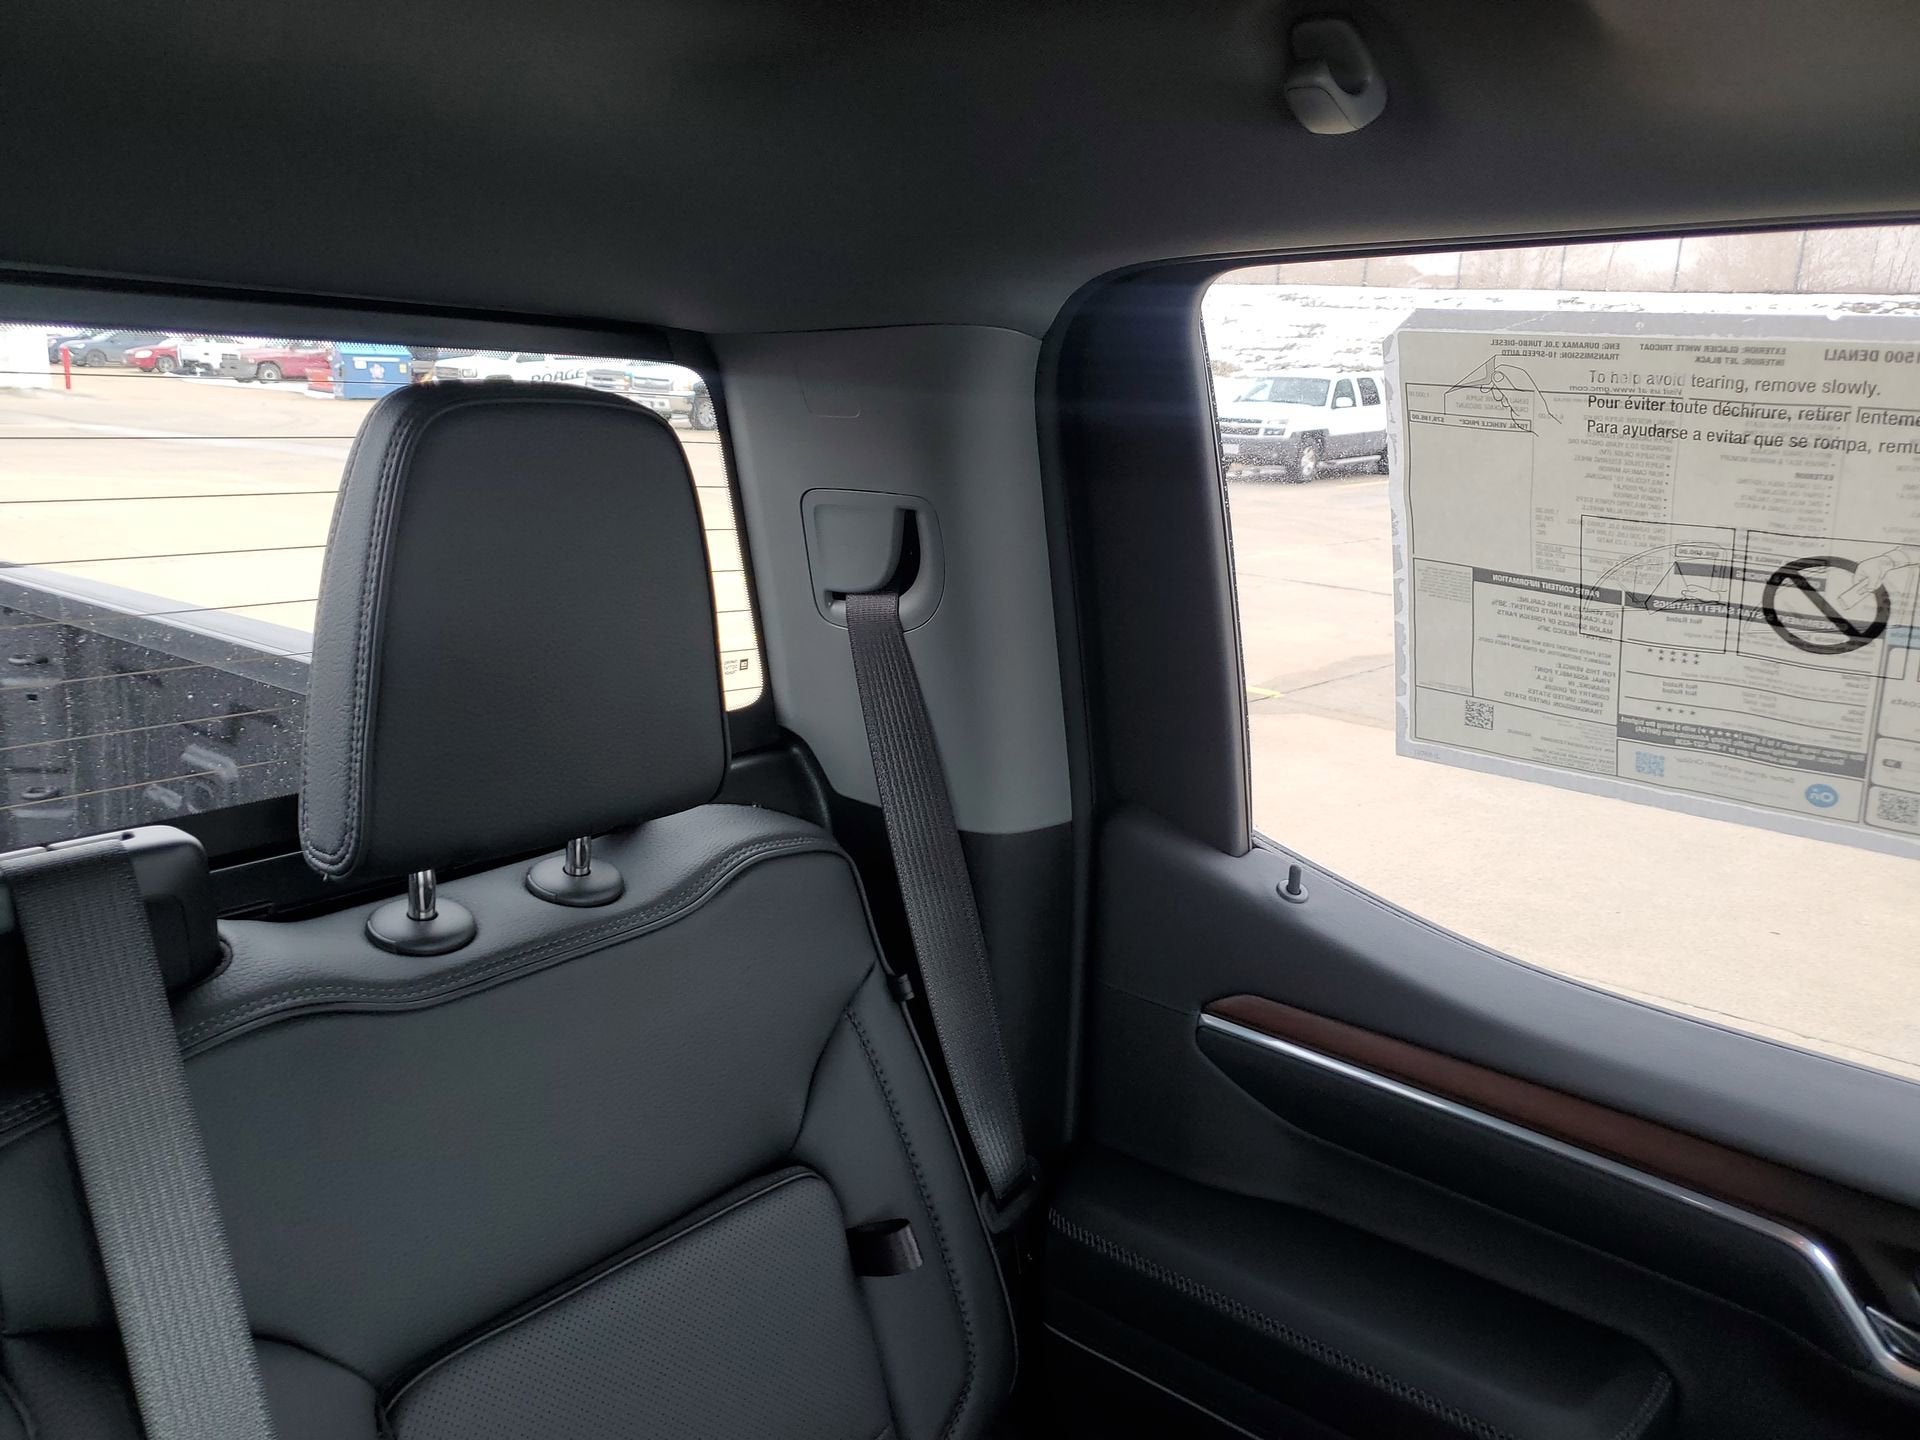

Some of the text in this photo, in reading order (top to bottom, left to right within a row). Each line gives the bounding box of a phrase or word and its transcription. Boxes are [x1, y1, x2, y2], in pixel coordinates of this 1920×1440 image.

[1589, 370, 1882, 398] To help avoid tearing, remove slowly.
[1588, 396, 1620, 409] Pour
[1624, 396, 1664, 411] éviter
[1670, 399, 1708, 415] toute
[1713, 402, 1792, 422] déchirure,
[1798, 406, 1851, 422] retirer
[1588, 420, 1618, 434] Para
[1623, 424, 1688, 440] ayudarse
[1693, 430, 1702, 441] a
[1706, 430, 1750, 445] evitar
[1754, 433, 1784, 450] que
[1788, 436, 1808, 448] se
[1814, 437, 1872, 455] rompa,
